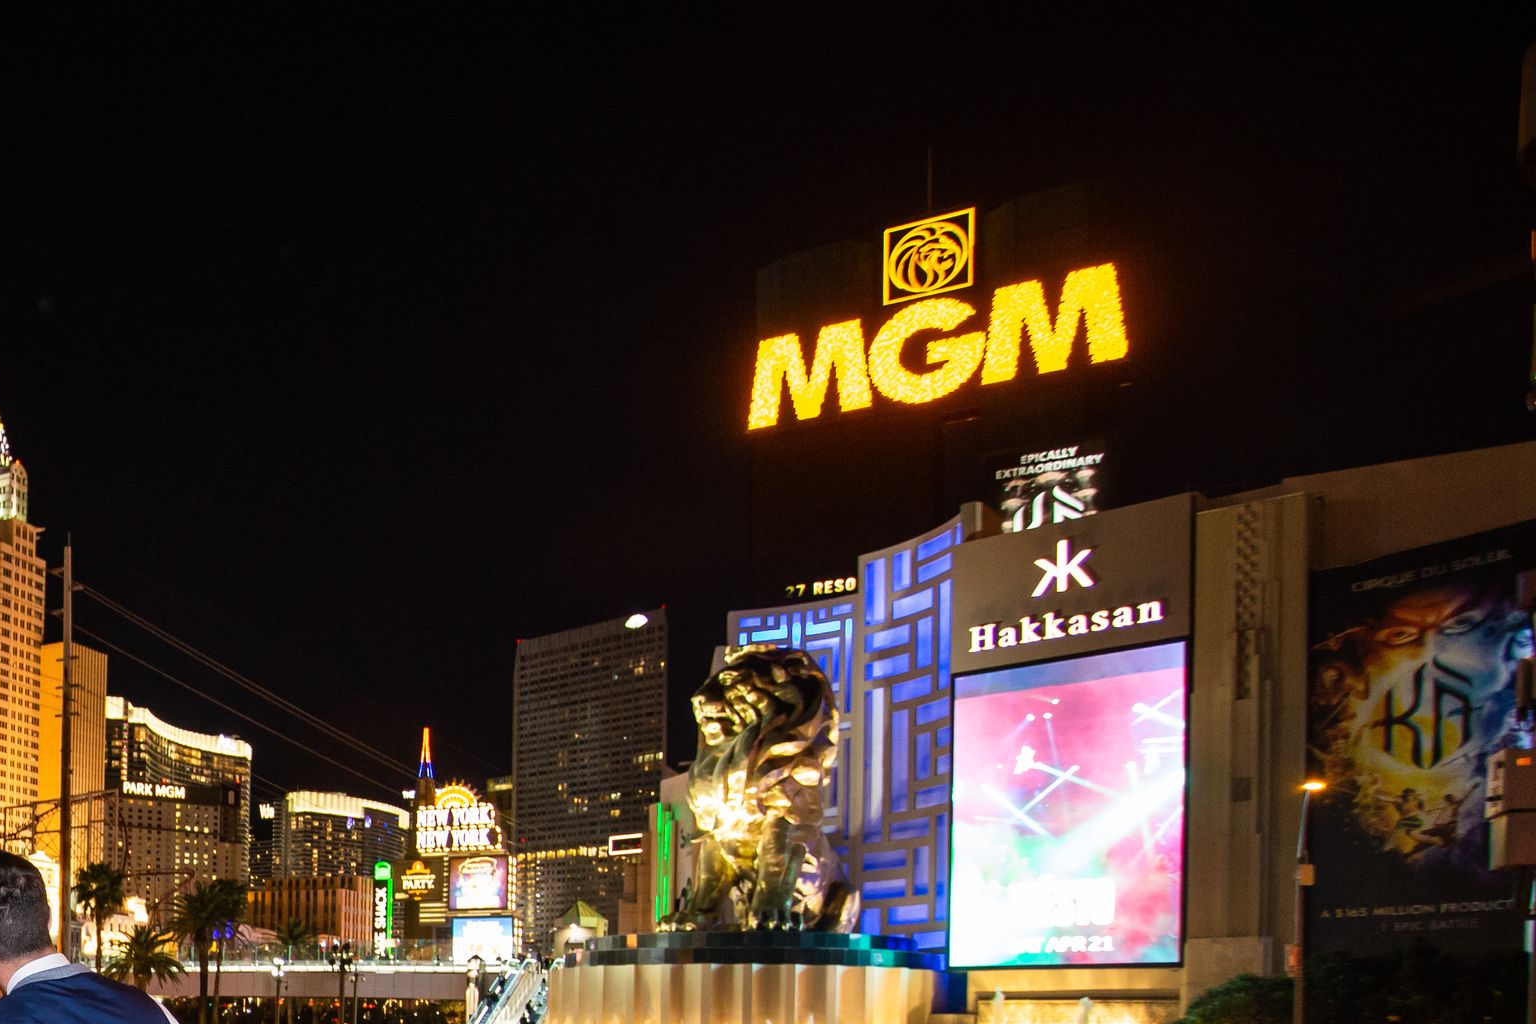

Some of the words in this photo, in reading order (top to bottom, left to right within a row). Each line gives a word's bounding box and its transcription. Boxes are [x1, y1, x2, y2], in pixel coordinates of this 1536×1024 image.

[748, 262, 1129, 431] MGM
[995, 453, 1104, 480] EXTRAORDINARY
[1020, 446, 1079, 465] EPICALLY
[812, 577, 857, 596] RESO
[1351, 569, 1417, 593] CIRQUE
[1420, 562, 1448, 580] DU
[968, 599, 1164, 653] Hakkasan
[123, 781, 153, 797] PARK
[155, 783, 186, 800] MGM
[416, 808, 449, 828] NEW
[450, 805, 492, 826] YORK
[416, 830, 450, 849] NEW
[450, 827, 491, 848] YORK
[374, 887, 387, 929] SHACK
[1372, 903, 1435, 917] MILLION
